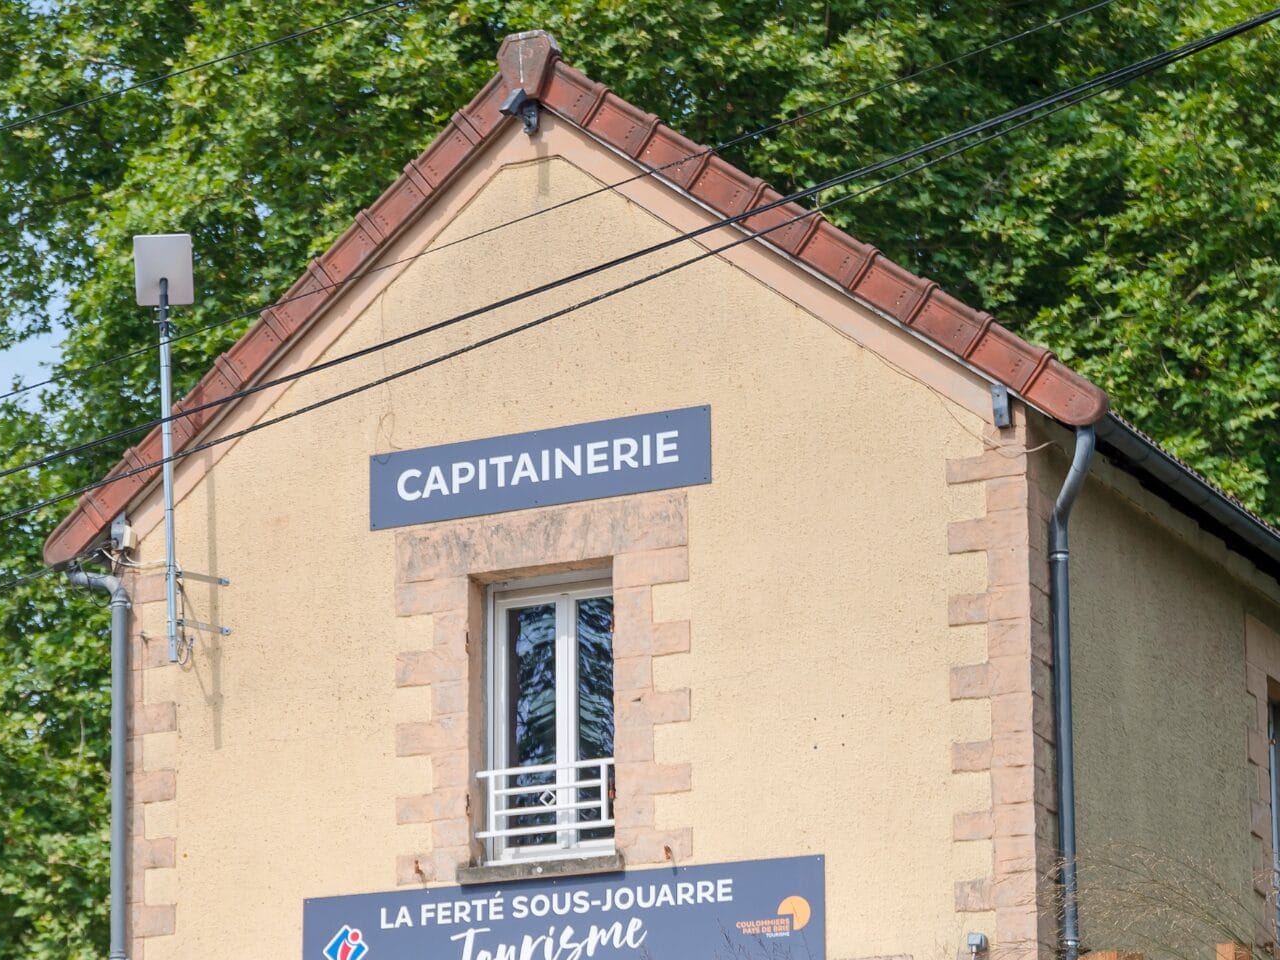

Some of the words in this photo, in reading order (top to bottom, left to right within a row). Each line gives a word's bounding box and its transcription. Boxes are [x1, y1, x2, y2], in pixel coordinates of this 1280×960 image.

[397, 430, 679, 501] CAPITAINERIE
[380, 907, 412, 929] LA
[420, 891, 504, 926] FERTÉ
[512, 879, 733, 919] SOUS-JOUARRE
[736, 918, 790, 928] COULOMMIERS
[743, 926, 761, 934] PAYS
